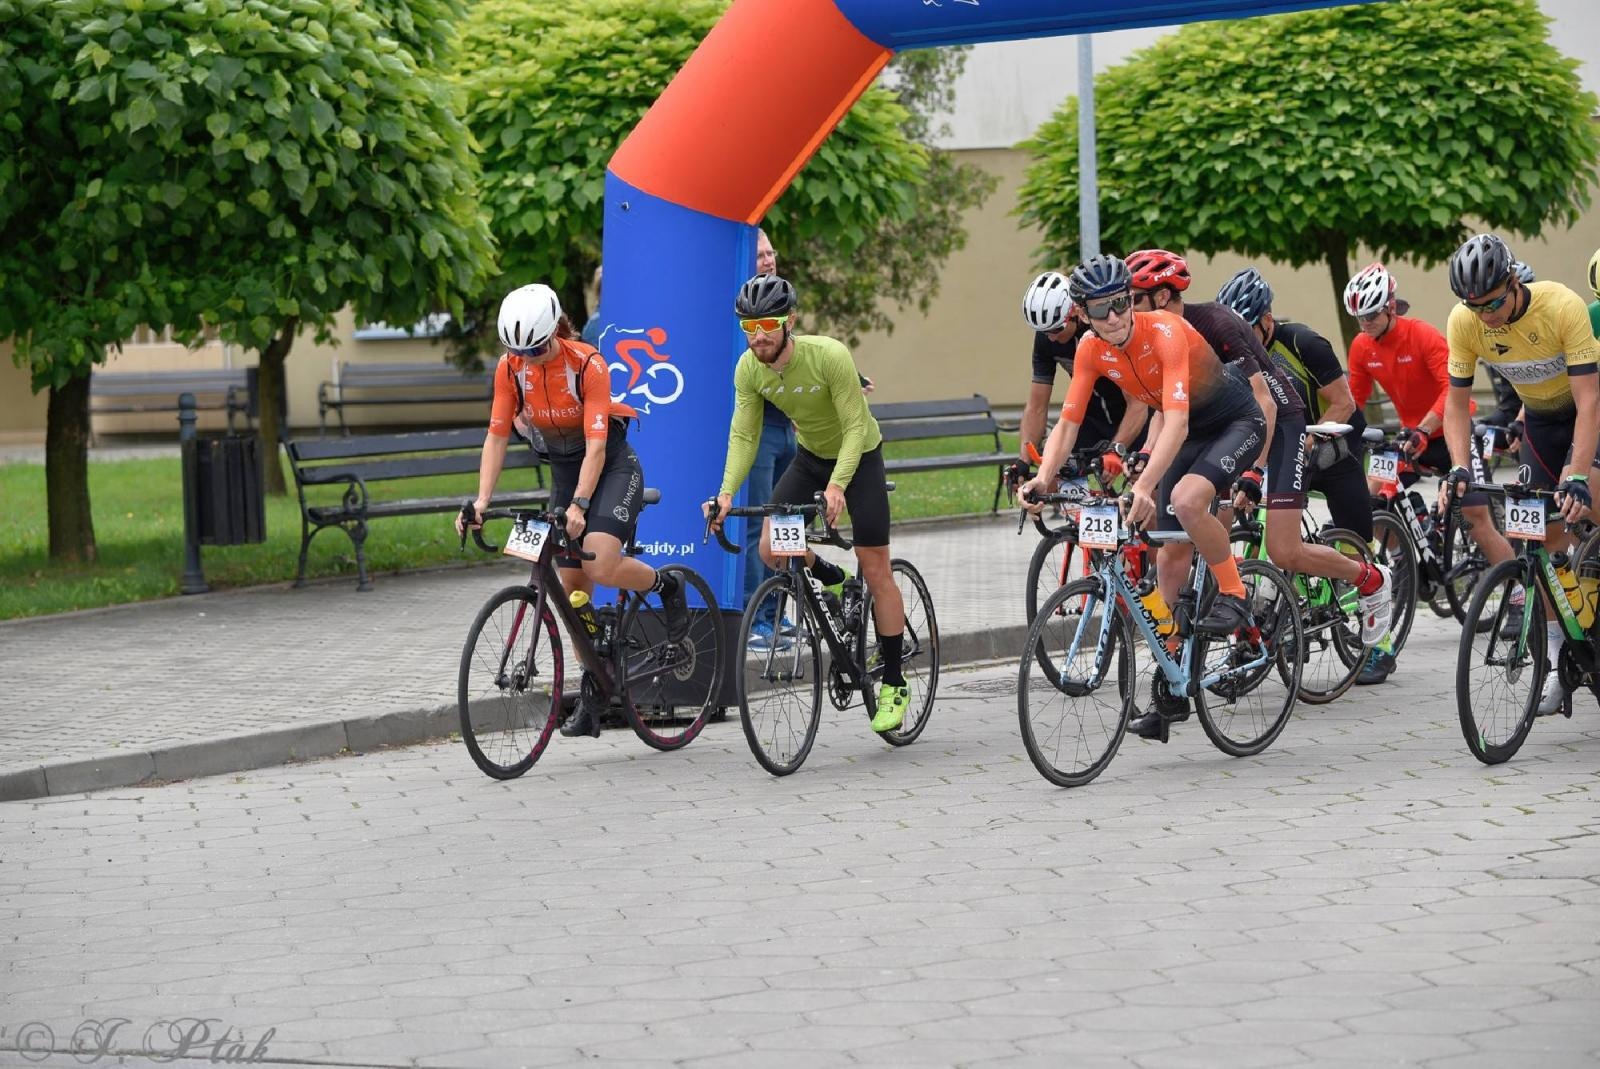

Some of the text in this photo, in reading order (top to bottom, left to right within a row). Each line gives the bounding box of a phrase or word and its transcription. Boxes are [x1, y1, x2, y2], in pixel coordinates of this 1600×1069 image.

[1373, 457, 1395, 472] 210
[1085, 516, 1113, 533] 218
[1510, 508, 1541, 525] 028
[774, 527, 800, 541] 133
